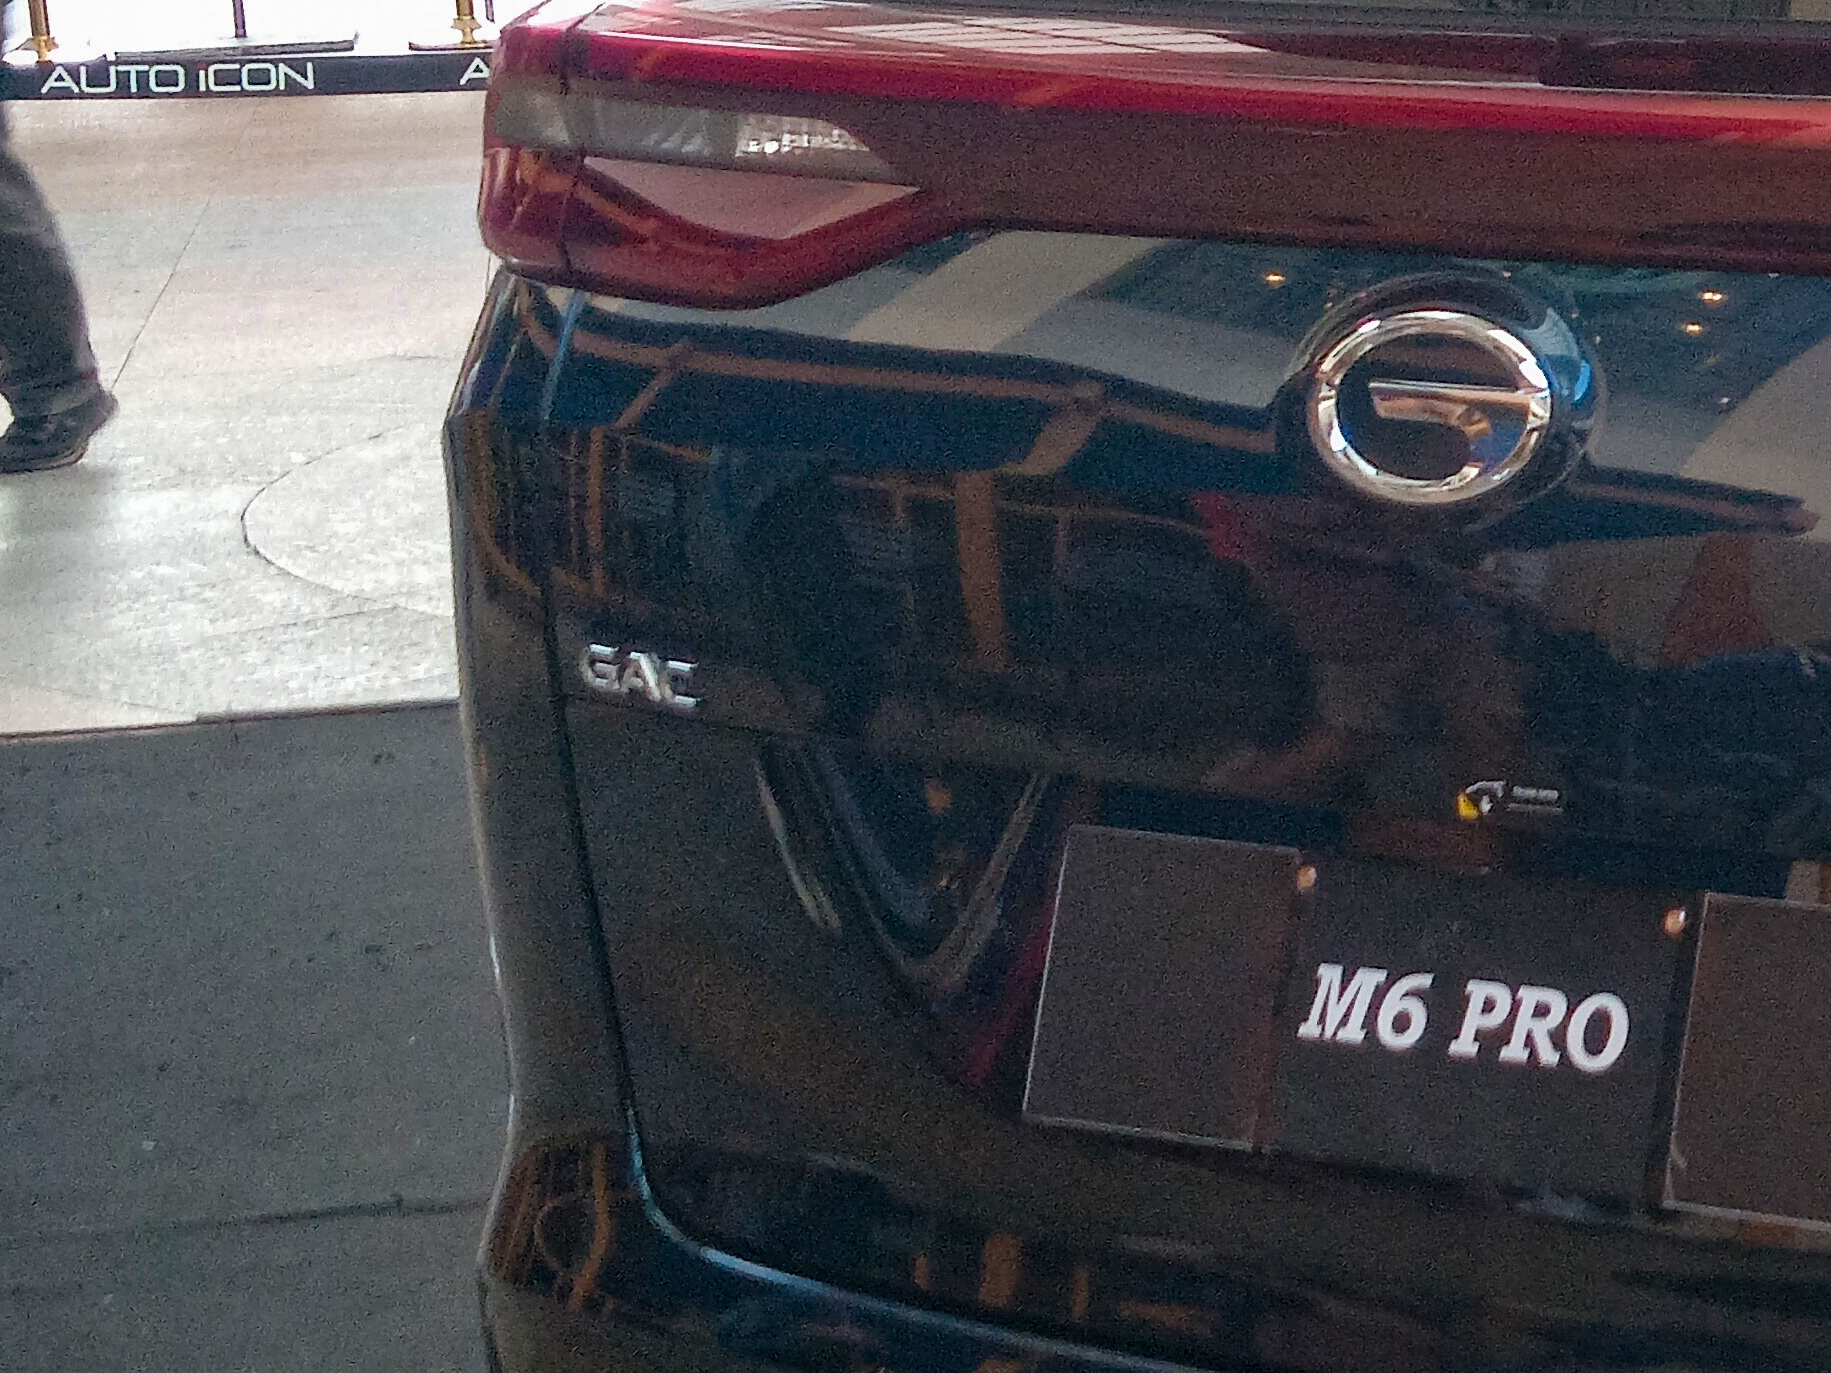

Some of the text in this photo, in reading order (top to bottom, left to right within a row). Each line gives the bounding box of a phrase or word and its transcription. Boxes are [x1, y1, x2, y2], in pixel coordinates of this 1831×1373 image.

[41, 63, 186, 94] AUTO
[1297, 962, 1630, 1074] M6 PRO
